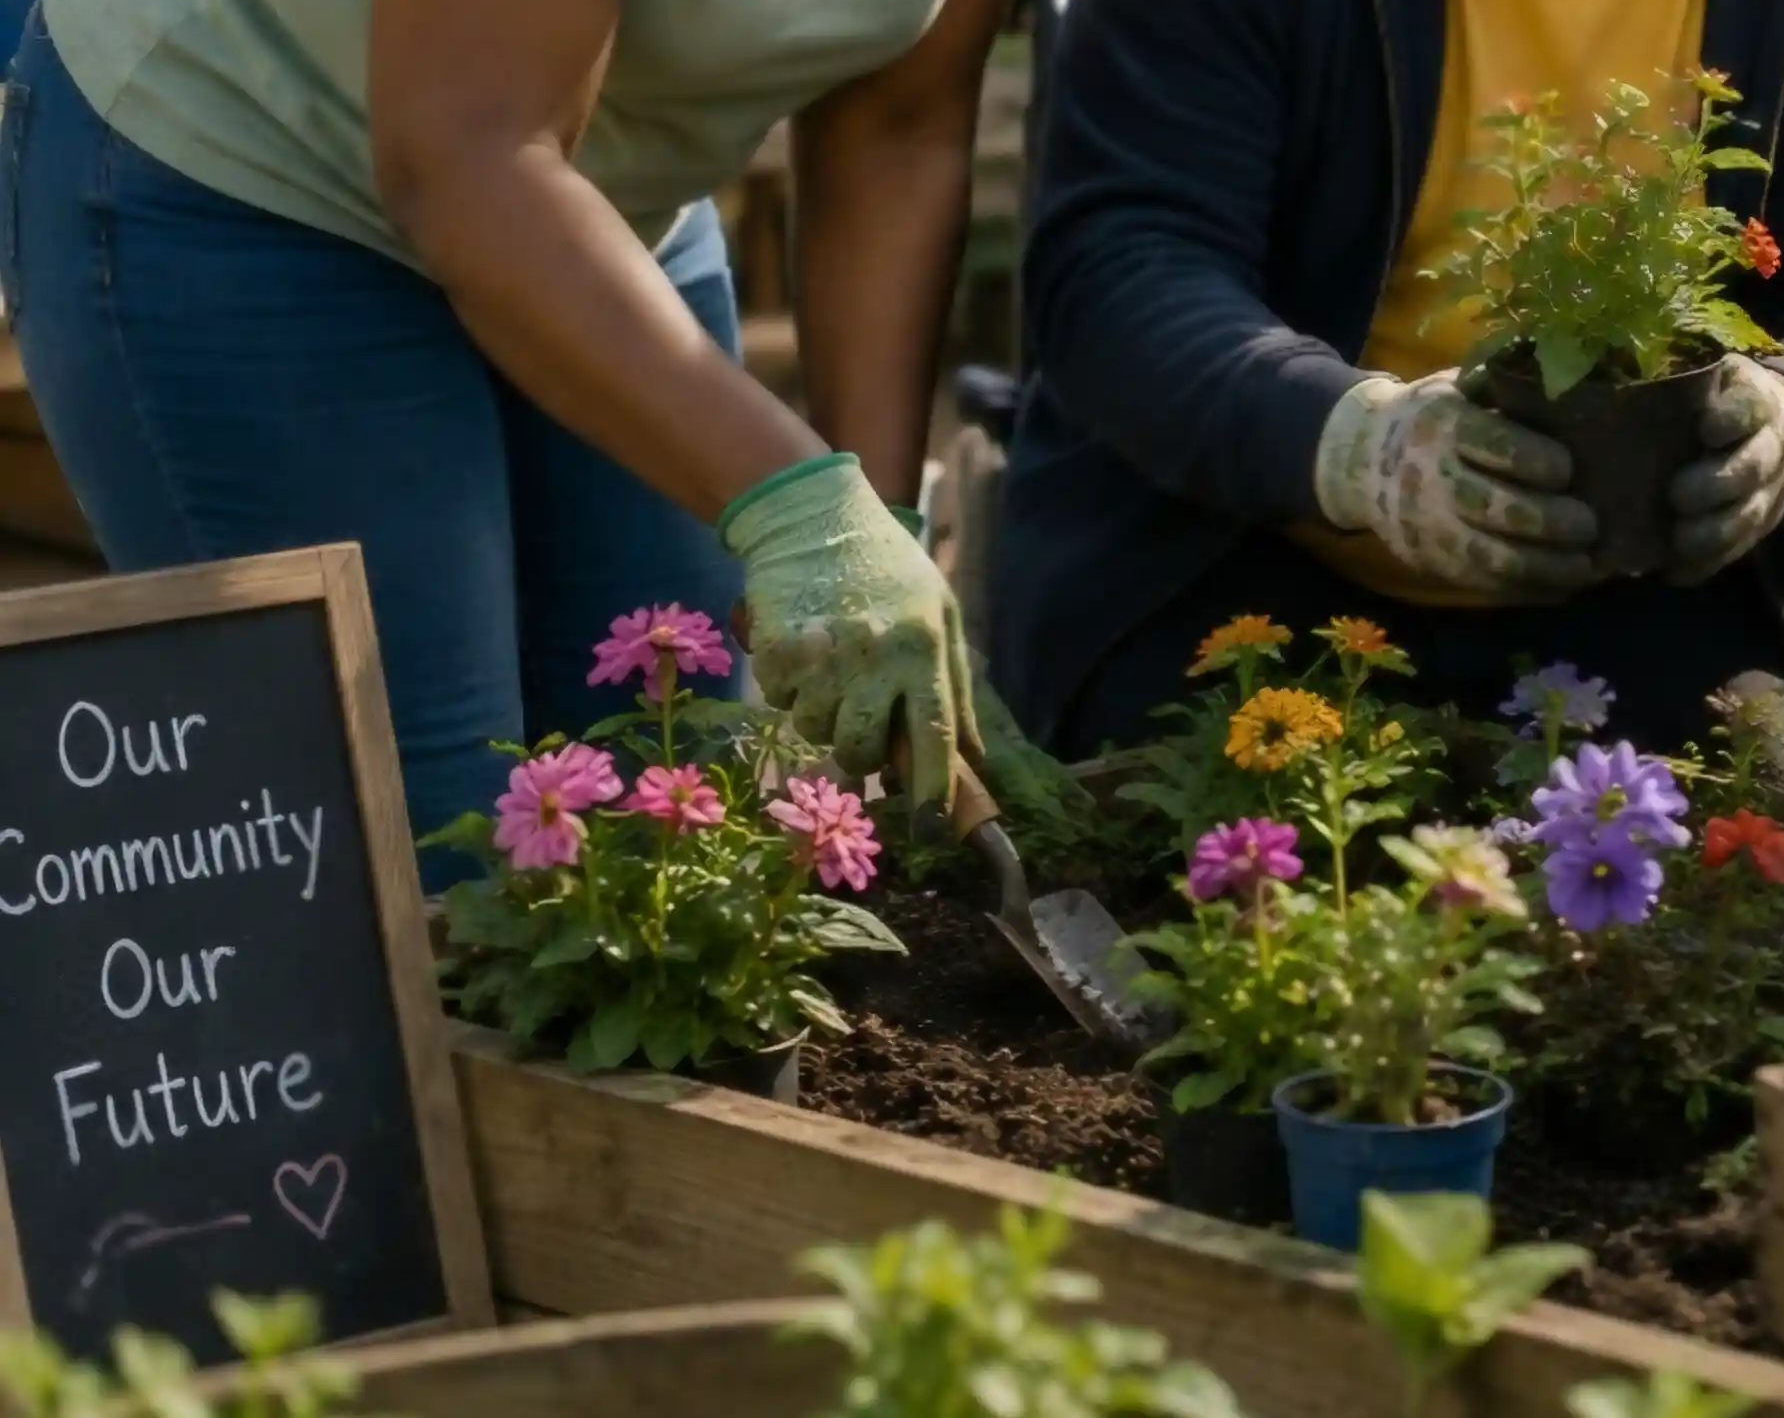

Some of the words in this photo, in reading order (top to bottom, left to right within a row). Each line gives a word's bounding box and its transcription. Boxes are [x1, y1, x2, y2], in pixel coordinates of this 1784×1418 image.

[58, 700, 208, 788] Our
[0, 787, 323, 916] Community
[101, 937, 237, 1019] Our
[53, 1052, 324, 1167] Future
